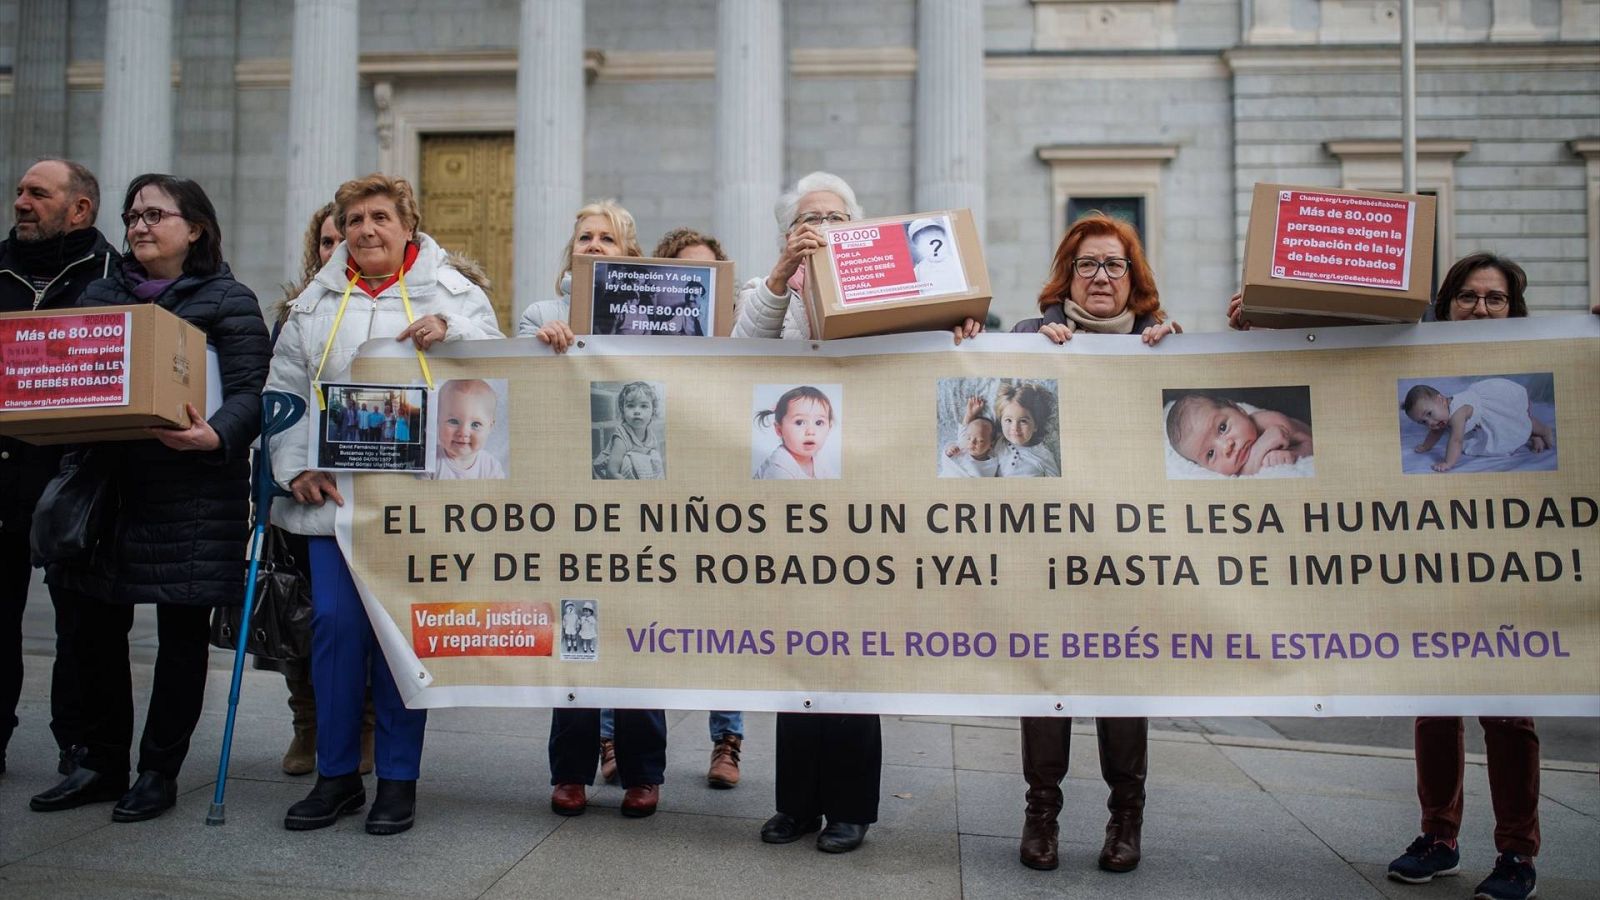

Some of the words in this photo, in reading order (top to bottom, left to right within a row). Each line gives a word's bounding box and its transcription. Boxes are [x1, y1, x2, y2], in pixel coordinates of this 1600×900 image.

[1299, 206, 1325, 218] Más
[1327, 208, 1342, 218] de
[1345, 210, 1392, 223] 80.000
[833, 229, 878, 242] 80.000
[1287, 222, 1345, 235] personas
[1347, 226, 1389, 240] exigen
[1391, 229, 1402, 240] la
[1283, 236, 1352, 250] aprobación
[1354, 242, 1369, 252] de
[1372, 243, 1383, 253] la
[1385, 244, 1404, 257] ley
[840, 256, 883, 267] APROBACIÓN
[874, 262, 896, 270] BEBÉS
[1288, 252, 1303, 262] de
[1305, 252, 1343, 266] bebés
[1345, 258, 1396, 270] robados
[608, 270, 663, 280] ¡Aprobación
[666, 273, 679, 281] YA
[680, 274, 692, 282] de
[842, 274, 875, 282] ROBADOS
[605, 283, 619, 292] ley
[633, 284, 661, 293] bebés
[662, 286, 703, 294] robados!
[844, 282, 871, 290] ESPAÑA
[609, 302, 637, 315] MÁS
[639, 306, 654, 315] DE
[656, 307, 699, 317] 80.000
[632, 320, 677, 331] FIRMAS
[16, 329, 45, 342] Más
[48, 328, 65, 340] de
[69, 325, 123, 339] 80.000
[68, 346, 98, 355] firmas
[6, 366, 15, 375] la
[17, 362, 78, 376] aprobación
[80, 361, 93, 372] de
[95, 361, 105, 371] la
[107, 360, 125, 370] LEY
[18, 379, 32, 389] DE
[34, 377, 69, 388] BEBÉS
[70, 375, 124, 386] ROBADOS
[4, 395, 122, 407] Change.org/LeyDeBebésRobados
[384, 504, 426, 534] EL
[444, 503, 556, 533] ROBO
[574, 503, 621, 533] DE
[640, 495, 767, 534] NIÑOS
[786, 503, 828, 534] ES
[848, 503, 906, 534] UN
[926, 503, 1095, 534] CRIMEN
[1116, 503, 1167, 533] DE
[1186, 503, 1284, 534] LESA
[1303, 496, 1599, 532] HUMANIDAD
[408, 553, 475, 583] LEY
[494, 553, 541, 582] DE
[559, 545, 677, 583] BEBÉS
[695, 554, 896, 586] ROBADOS
[916, 554, 998, 590] ¡YA!
[1048, 555, 1200, 590] ¡BASTA
[1217, 555, 1269, 586] DE
[1289, 549, 1582, 586] IMPUNIDAD!
[415, 608, 481, 628] Verdad,
[485, 608, 548, 629] justicia
[428, 636, 438, 653] y
[443, 630, 536, 652] reparación
[626, 621, 776, 655] VÍCTIMAS
[786, 630, 851, 656] POR
[862, 631, 895, 657] EL
[905, 632, 997, 658] ROBO
[1009, 633, 1049, 659] DE
[1062, 626, 1160, 660] BEBÉS
[1172, 633, 1213, 660] EN
[1226, 633, 1261, 660] EL
[1272, 632, 1400, 660] ESTADO
[1412, 624, 1571, 659] ESPAÑOL
